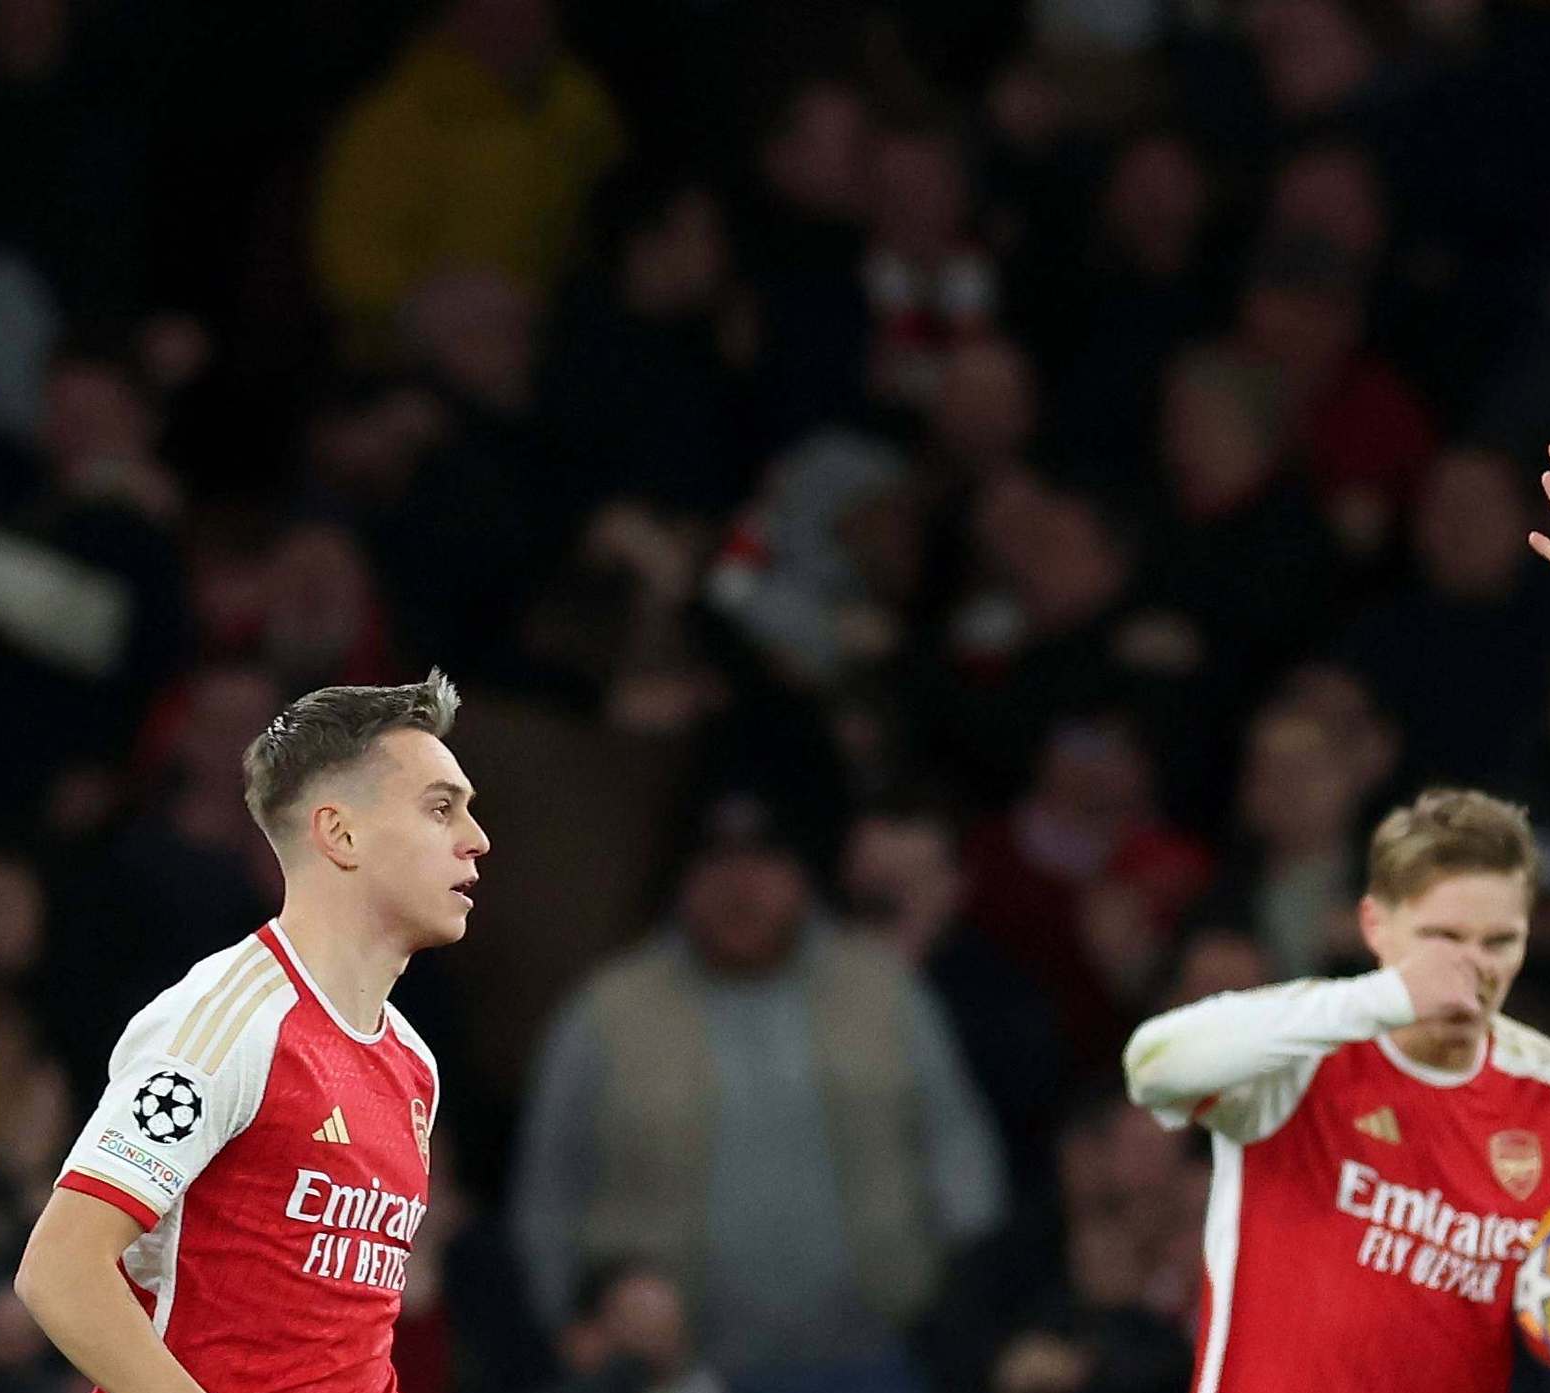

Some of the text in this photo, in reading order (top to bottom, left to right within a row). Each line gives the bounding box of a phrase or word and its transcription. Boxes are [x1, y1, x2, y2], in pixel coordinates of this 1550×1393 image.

[98, 1134, 184, 1190] FOUNDATION
[1336, 1157, 1541, 1263] Emirates
[302, 1232, 352, 1279] FLY
